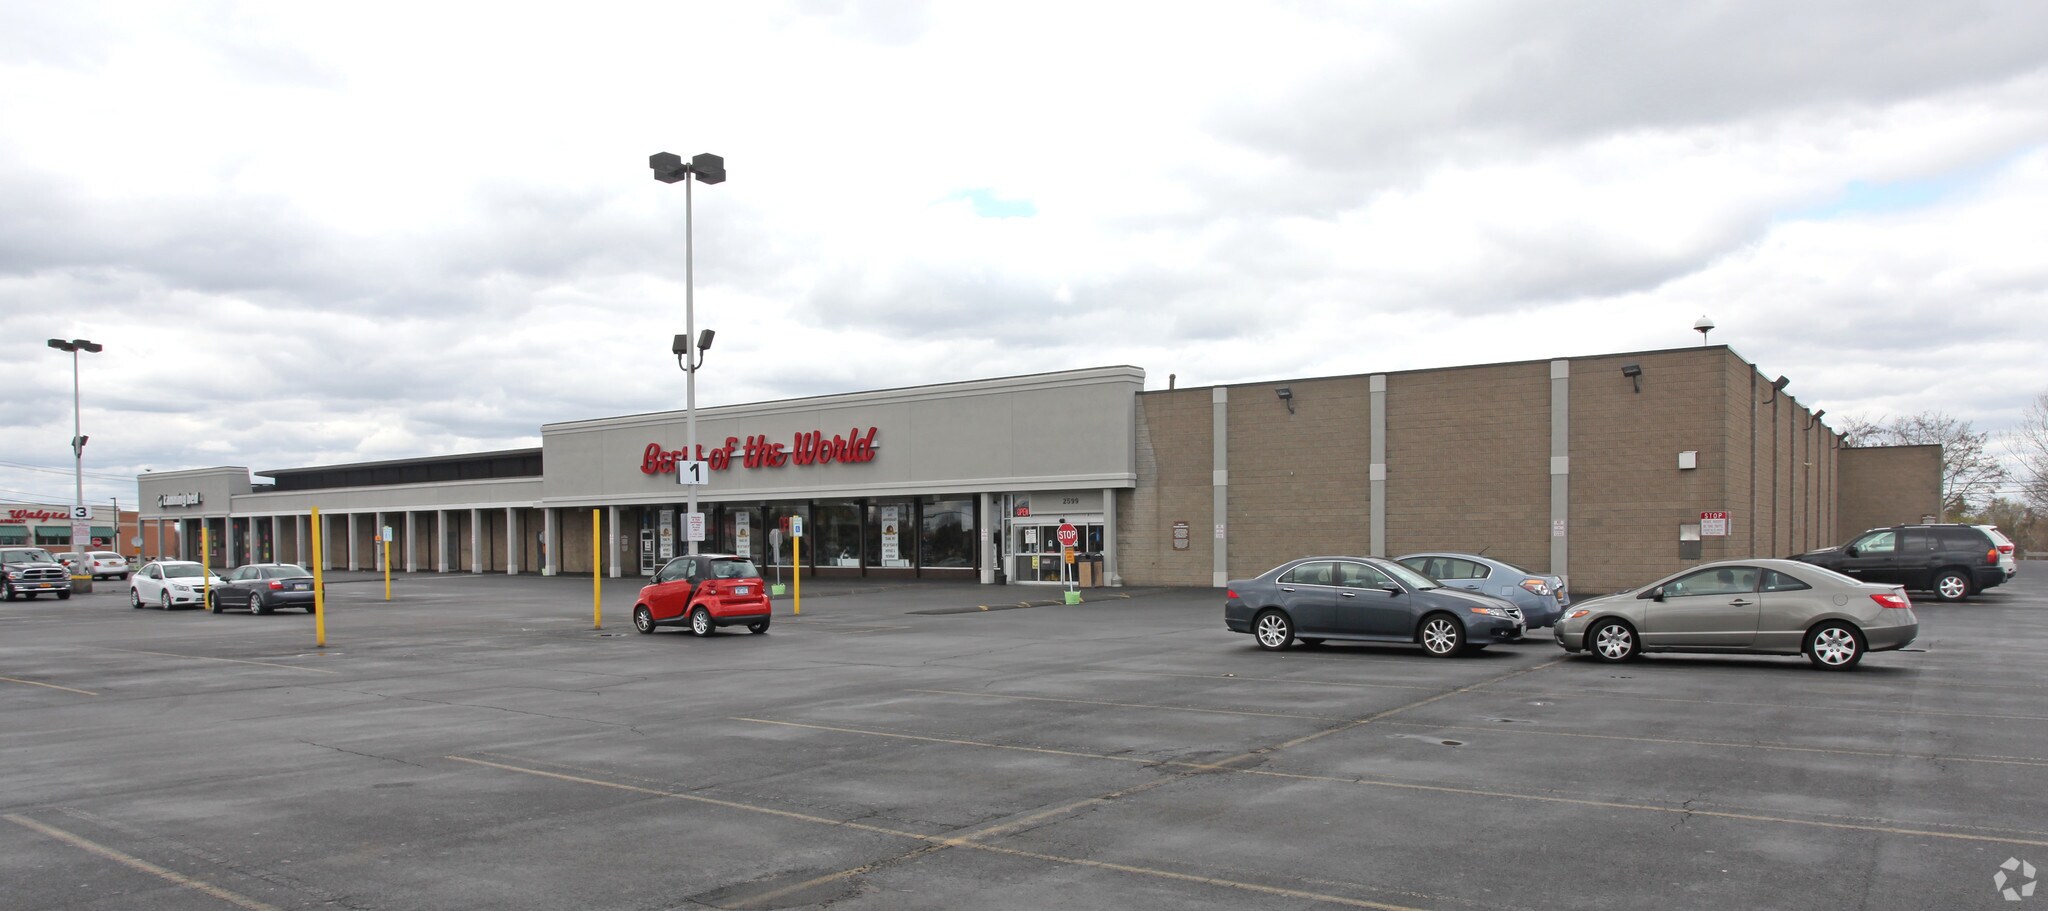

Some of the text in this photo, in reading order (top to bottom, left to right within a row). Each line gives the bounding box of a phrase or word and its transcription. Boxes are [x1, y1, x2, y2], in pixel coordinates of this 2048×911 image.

[708, 437, 738, 471] of
[743, 434, 787, 469] the
[792, 427, 878, 465] World
[689, 463, 700, 482] 1
[75, 507, 87, 517] 3
[1016, 507, 1029, 516] OPEN
[1059, 530, 1076, 540] STOP
